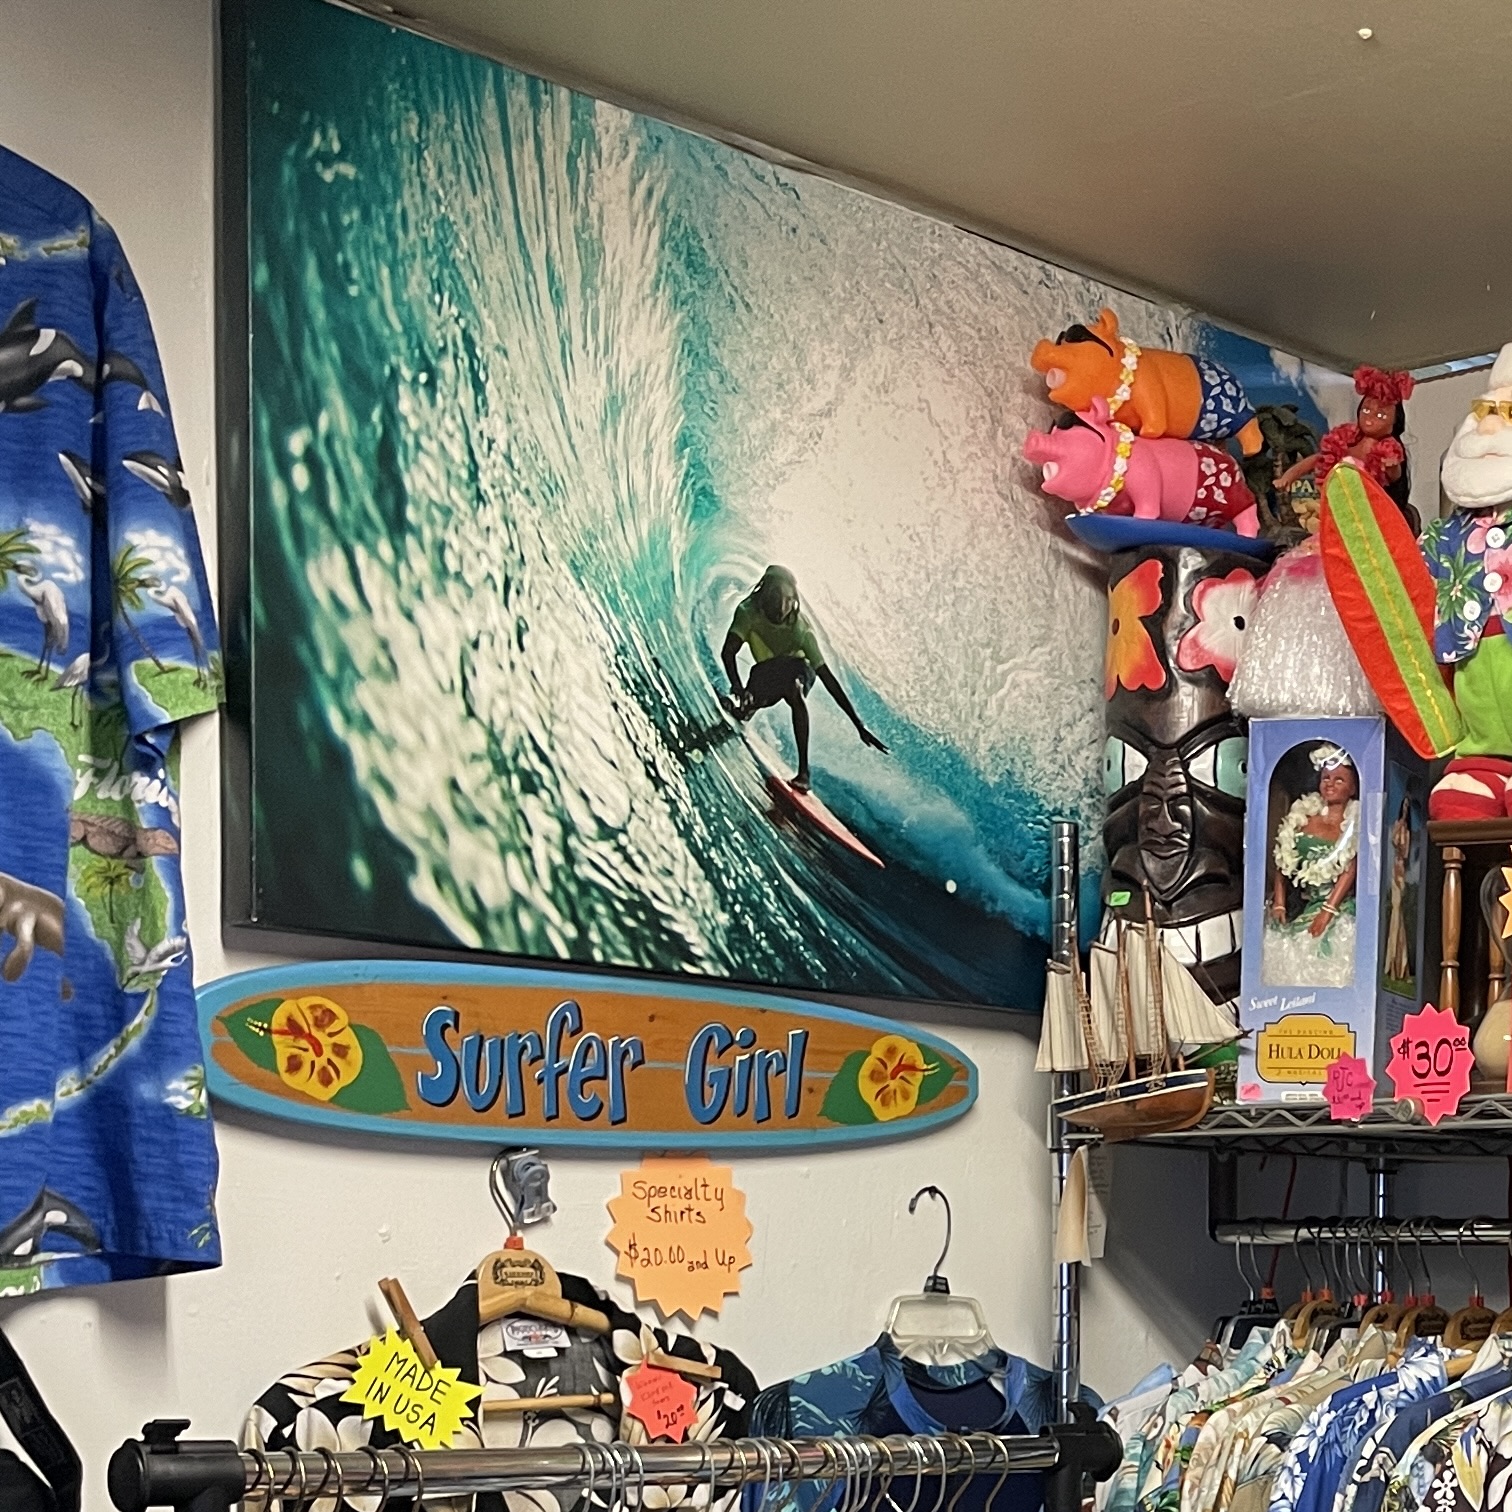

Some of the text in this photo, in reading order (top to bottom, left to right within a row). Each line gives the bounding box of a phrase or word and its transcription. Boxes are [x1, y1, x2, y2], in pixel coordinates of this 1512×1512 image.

[417, 1000, 809, 1125] Surfer Girl
[632, 1177, 724, 1211] Specialty
[646, 1204, 706, 1224] Shirts
[624, 1232, 685, 1268] $20.00
[687, 1250, 709, 1272] and
[384, 1352, 452, 1406] MADE
[365, 1377, 436, 1436] IN USA
